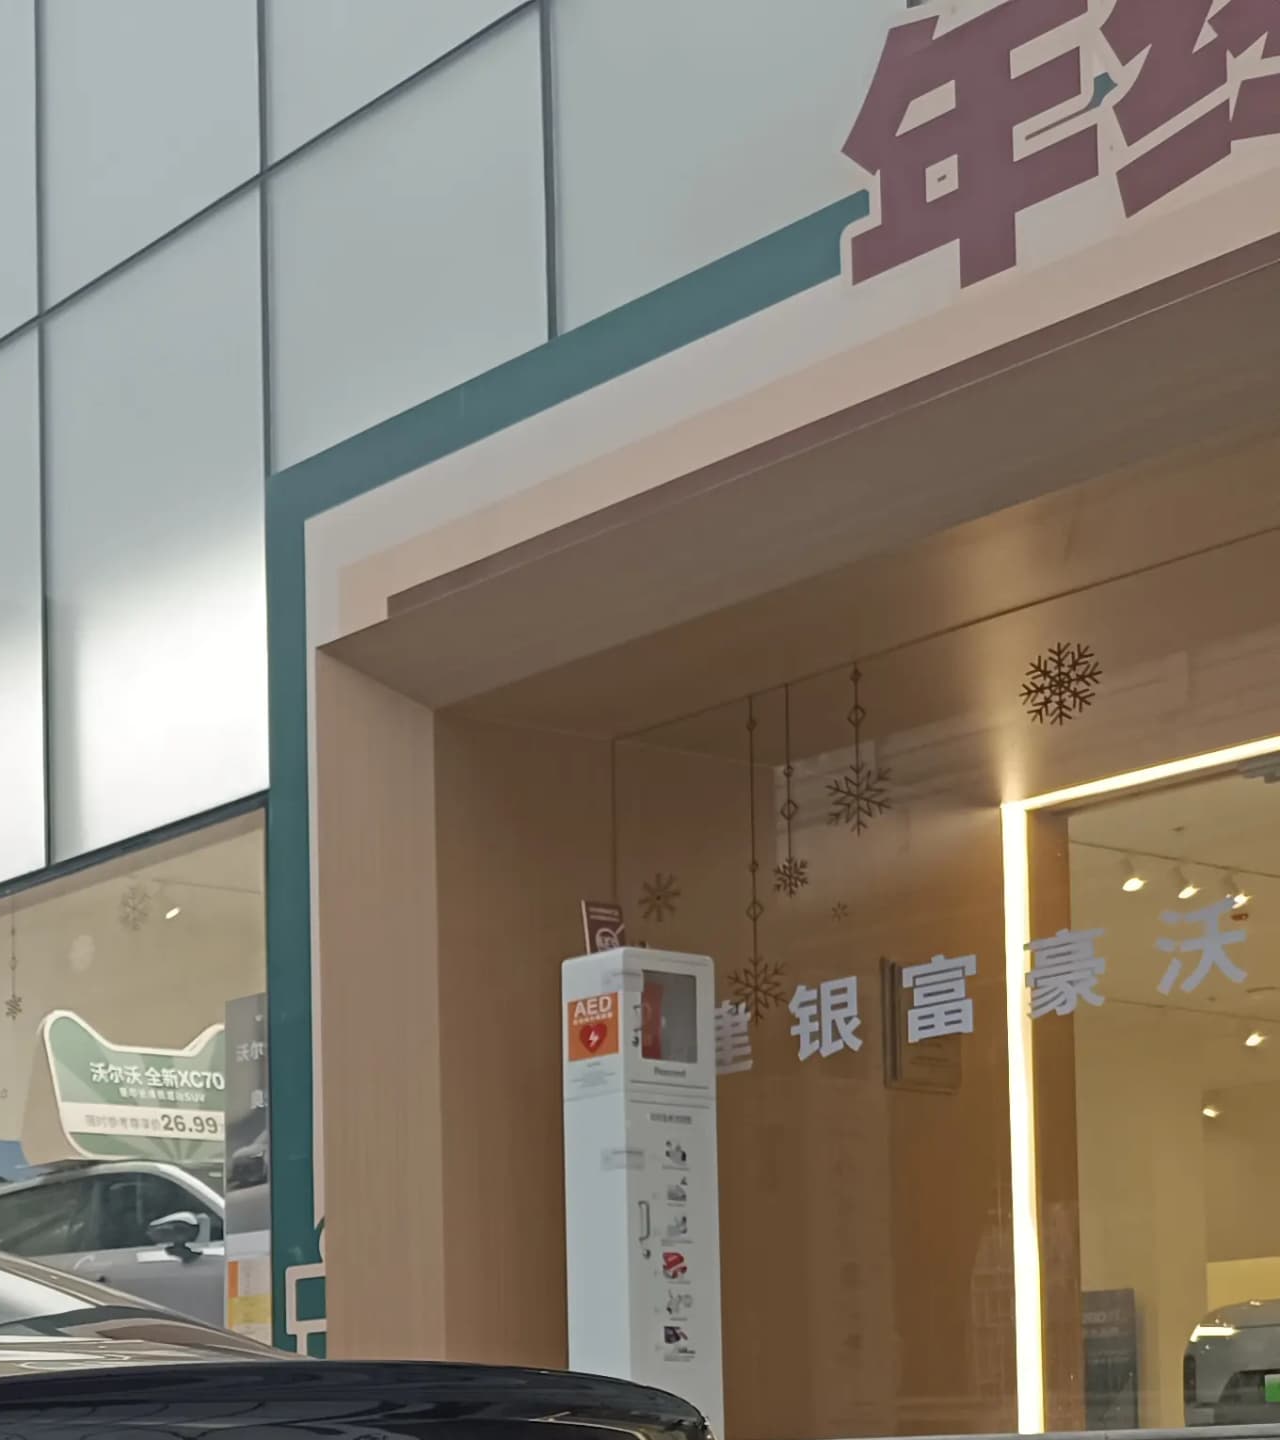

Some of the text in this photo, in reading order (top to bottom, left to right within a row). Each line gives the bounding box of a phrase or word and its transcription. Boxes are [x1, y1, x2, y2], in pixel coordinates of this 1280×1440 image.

[574, 995, 613, 1018] AED
[89, 1062, 225, 1090] 沃尔沃 全新XC70
